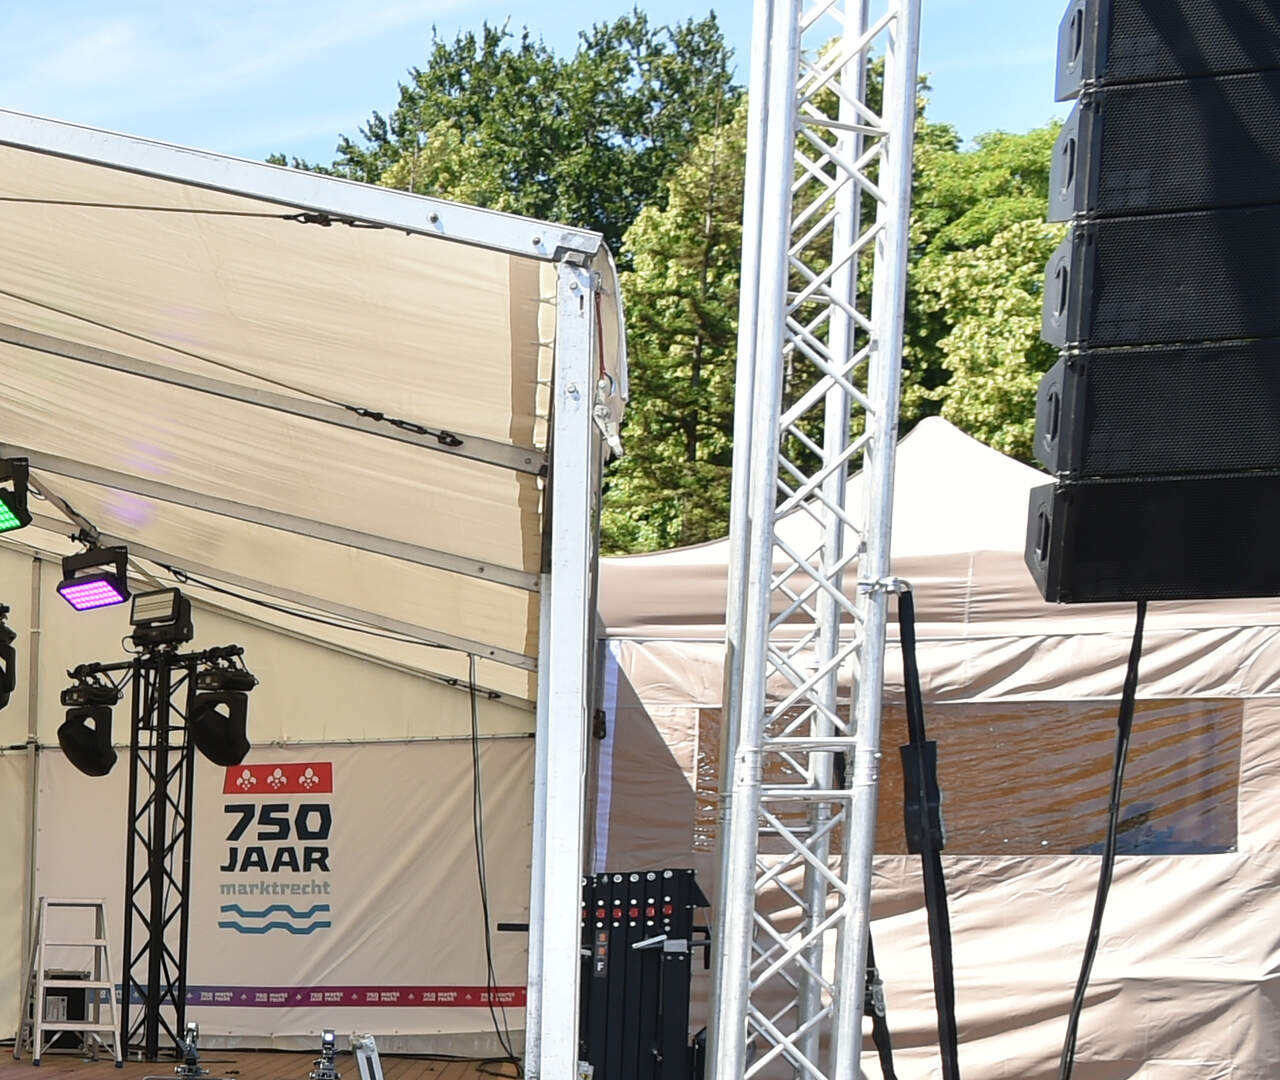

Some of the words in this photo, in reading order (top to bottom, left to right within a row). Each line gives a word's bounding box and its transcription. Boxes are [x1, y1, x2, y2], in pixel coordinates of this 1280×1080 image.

[224, 804, 332, 841] 750
[220, 846, 330, 872] JAAR
[220, 880, 331, 895] marktrecht
